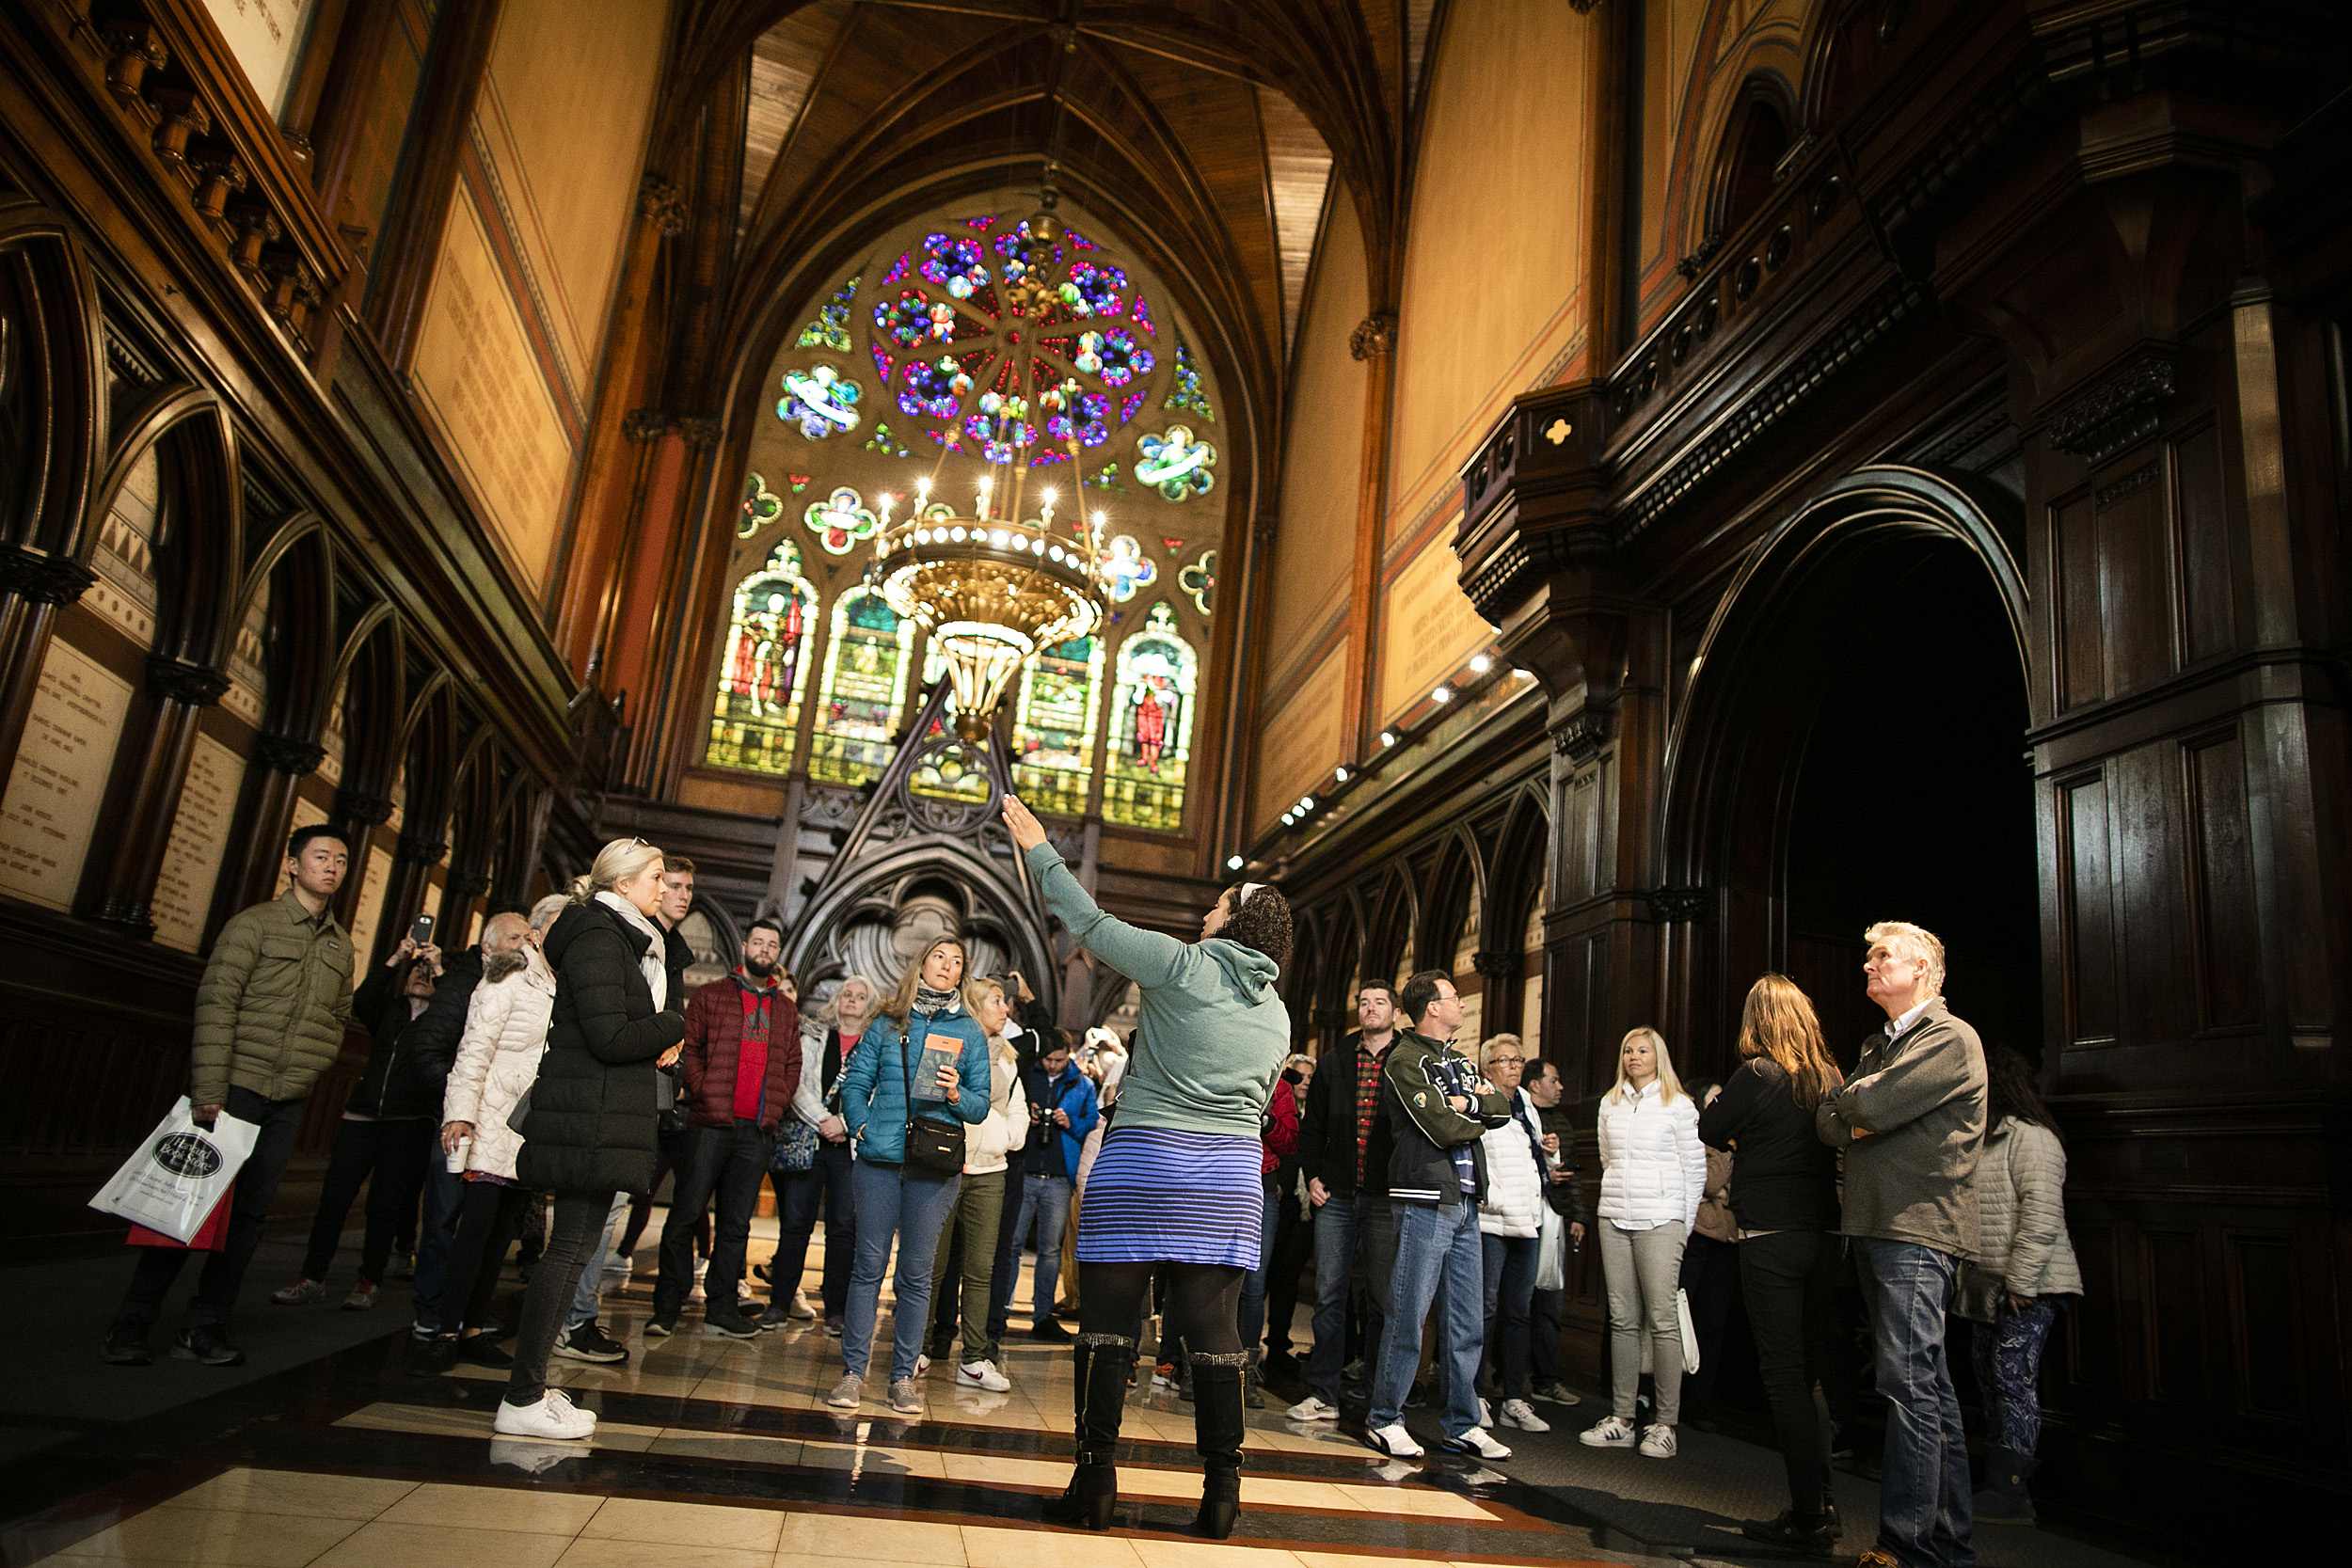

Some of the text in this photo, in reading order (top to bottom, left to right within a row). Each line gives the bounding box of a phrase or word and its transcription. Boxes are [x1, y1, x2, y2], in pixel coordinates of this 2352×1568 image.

[160, 1143, 185, 1160] Book
[185, 1153, 213, 1172] Store
[173, 1137, 213, 1160] Harvard
